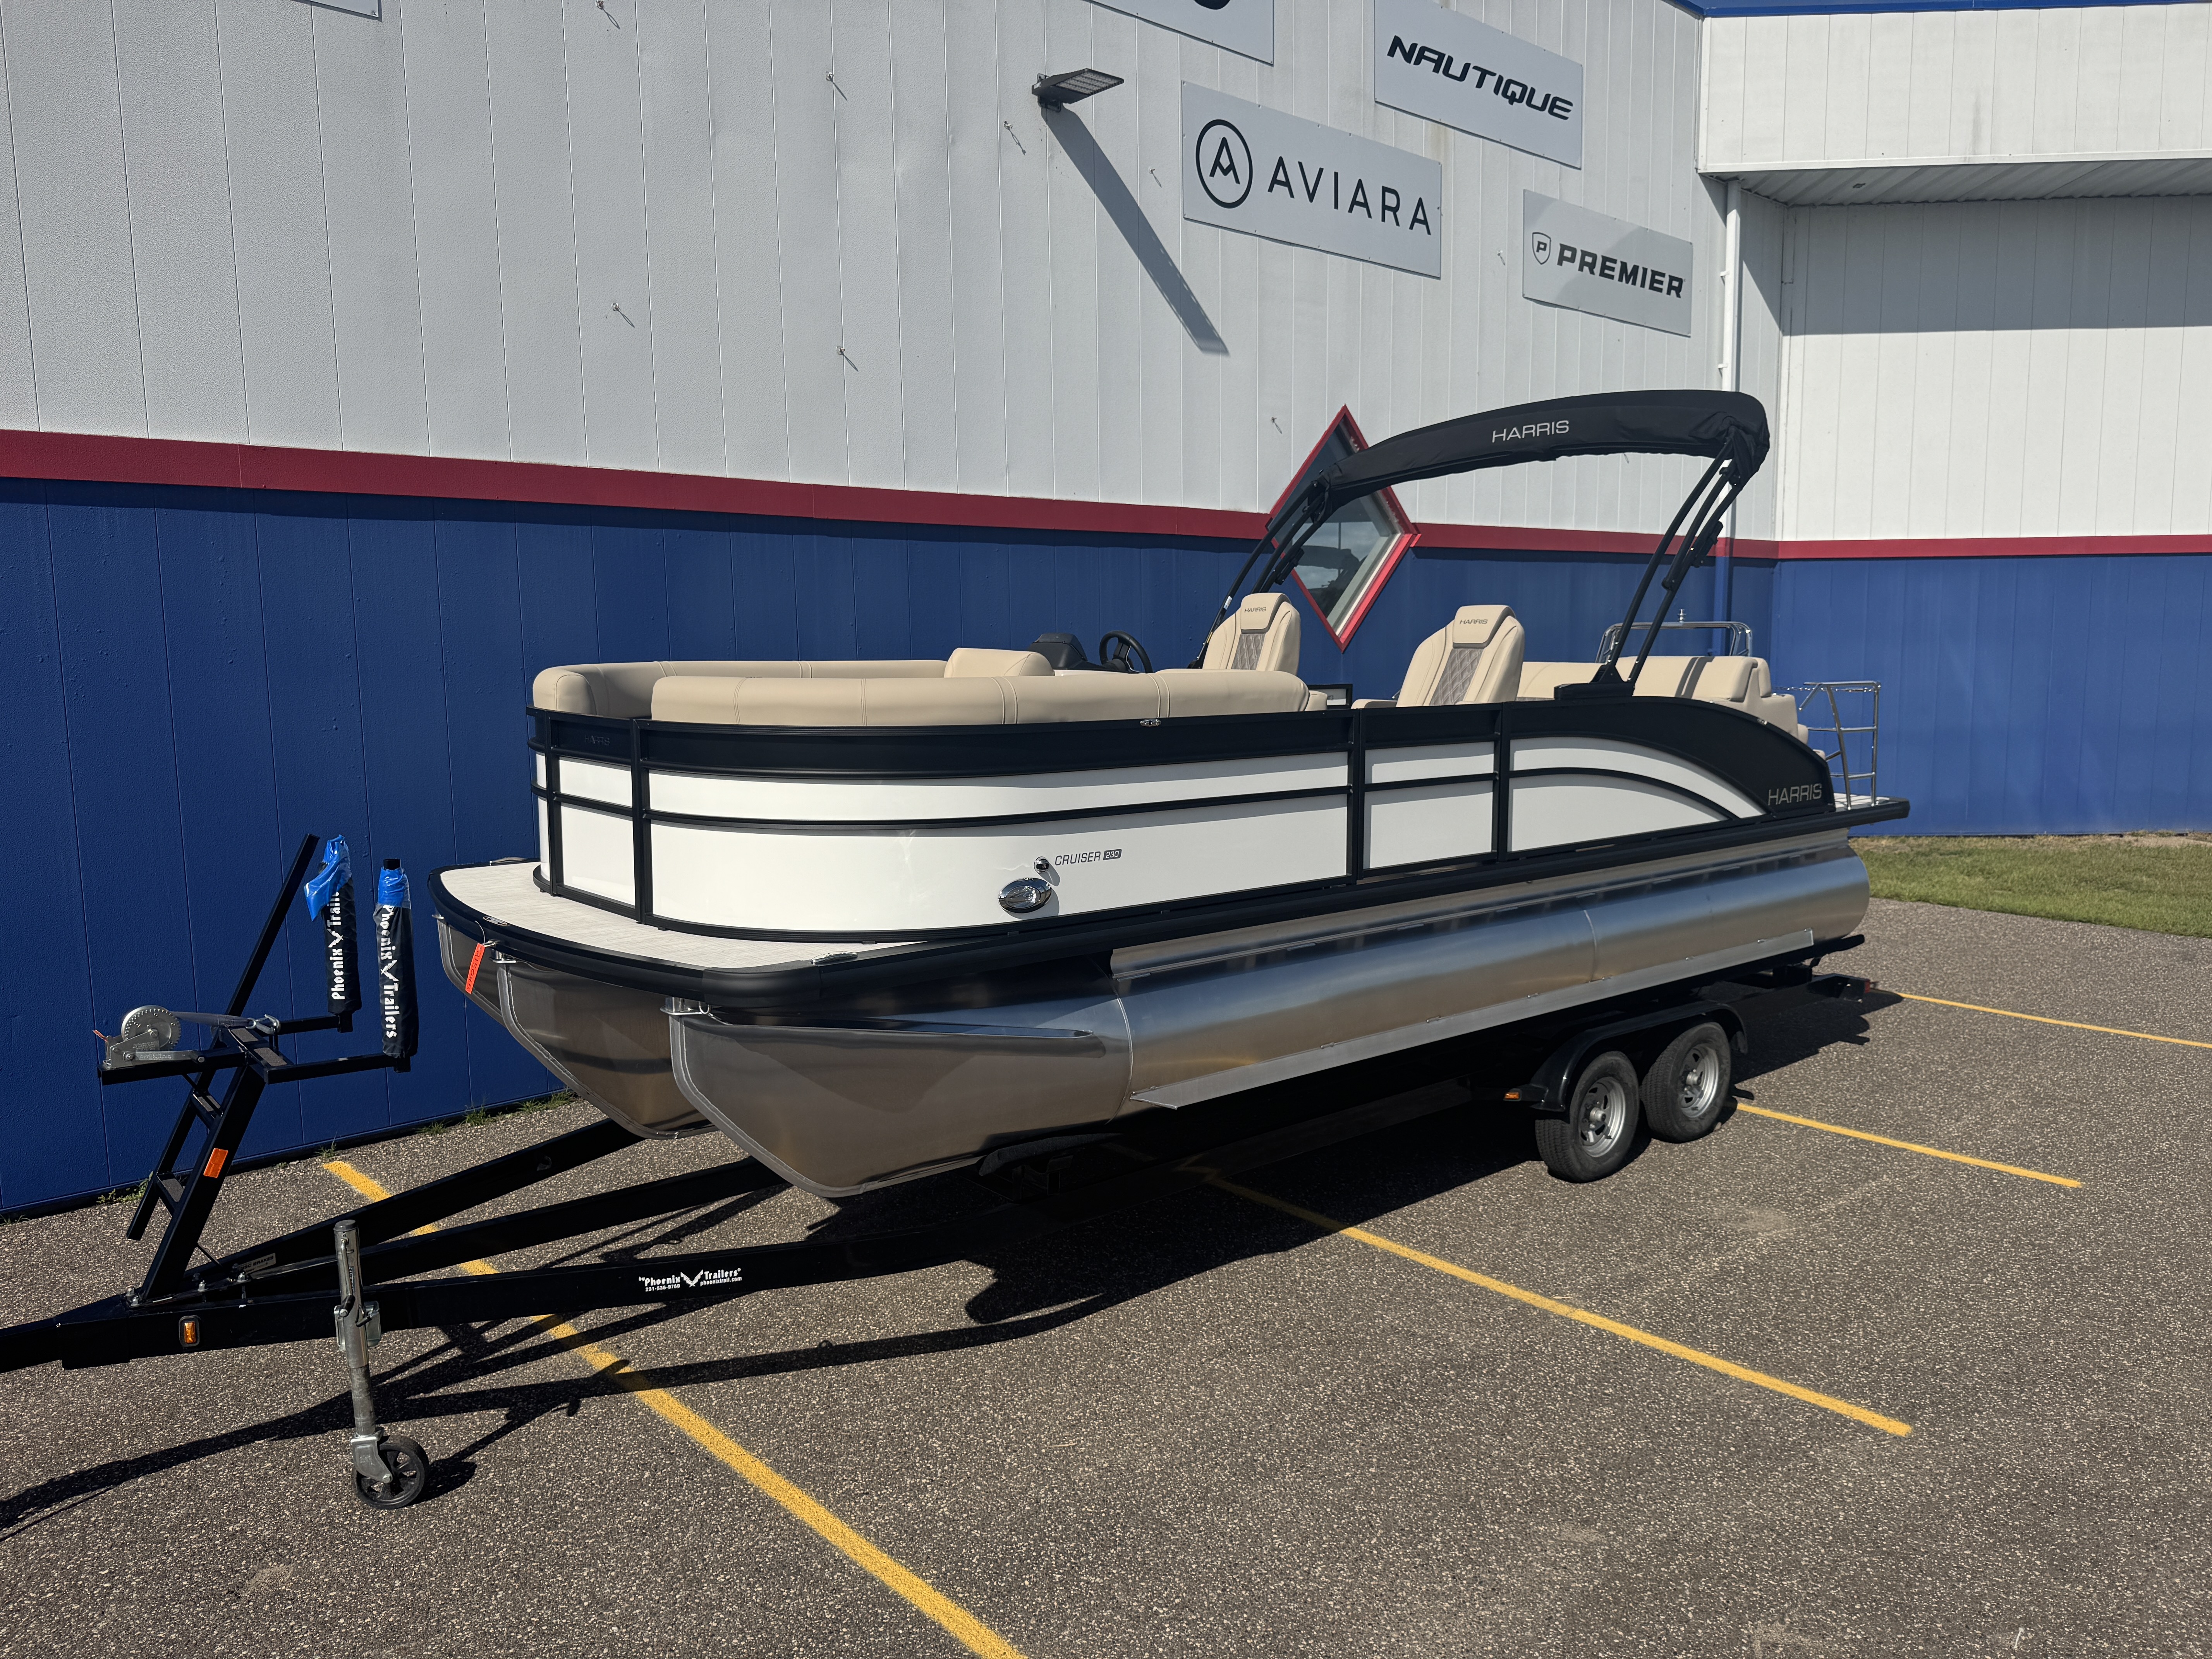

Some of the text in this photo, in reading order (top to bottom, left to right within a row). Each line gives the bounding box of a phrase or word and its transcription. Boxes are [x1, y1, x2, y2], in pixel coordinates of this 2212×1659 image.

[1387, 35, 1573, 120] NAUTIQUE
[1267, 156, 1431, 235] AVIARA
[1557, 243, 1683, 299] PREMIER
[1492, 420, 1569, 443] HARRIS
[1768, 783, 1822, 805] HARRIS
[1055, 850, 1120, 866] CRUISER 230
[329, 948, 345, 1000] Phoenix
[383, 978, 400, 1038] Trailers
[645, 1275, 680, 1286] Phoenix
[700, 1276, 742, 1286] phoenixtrail.com
